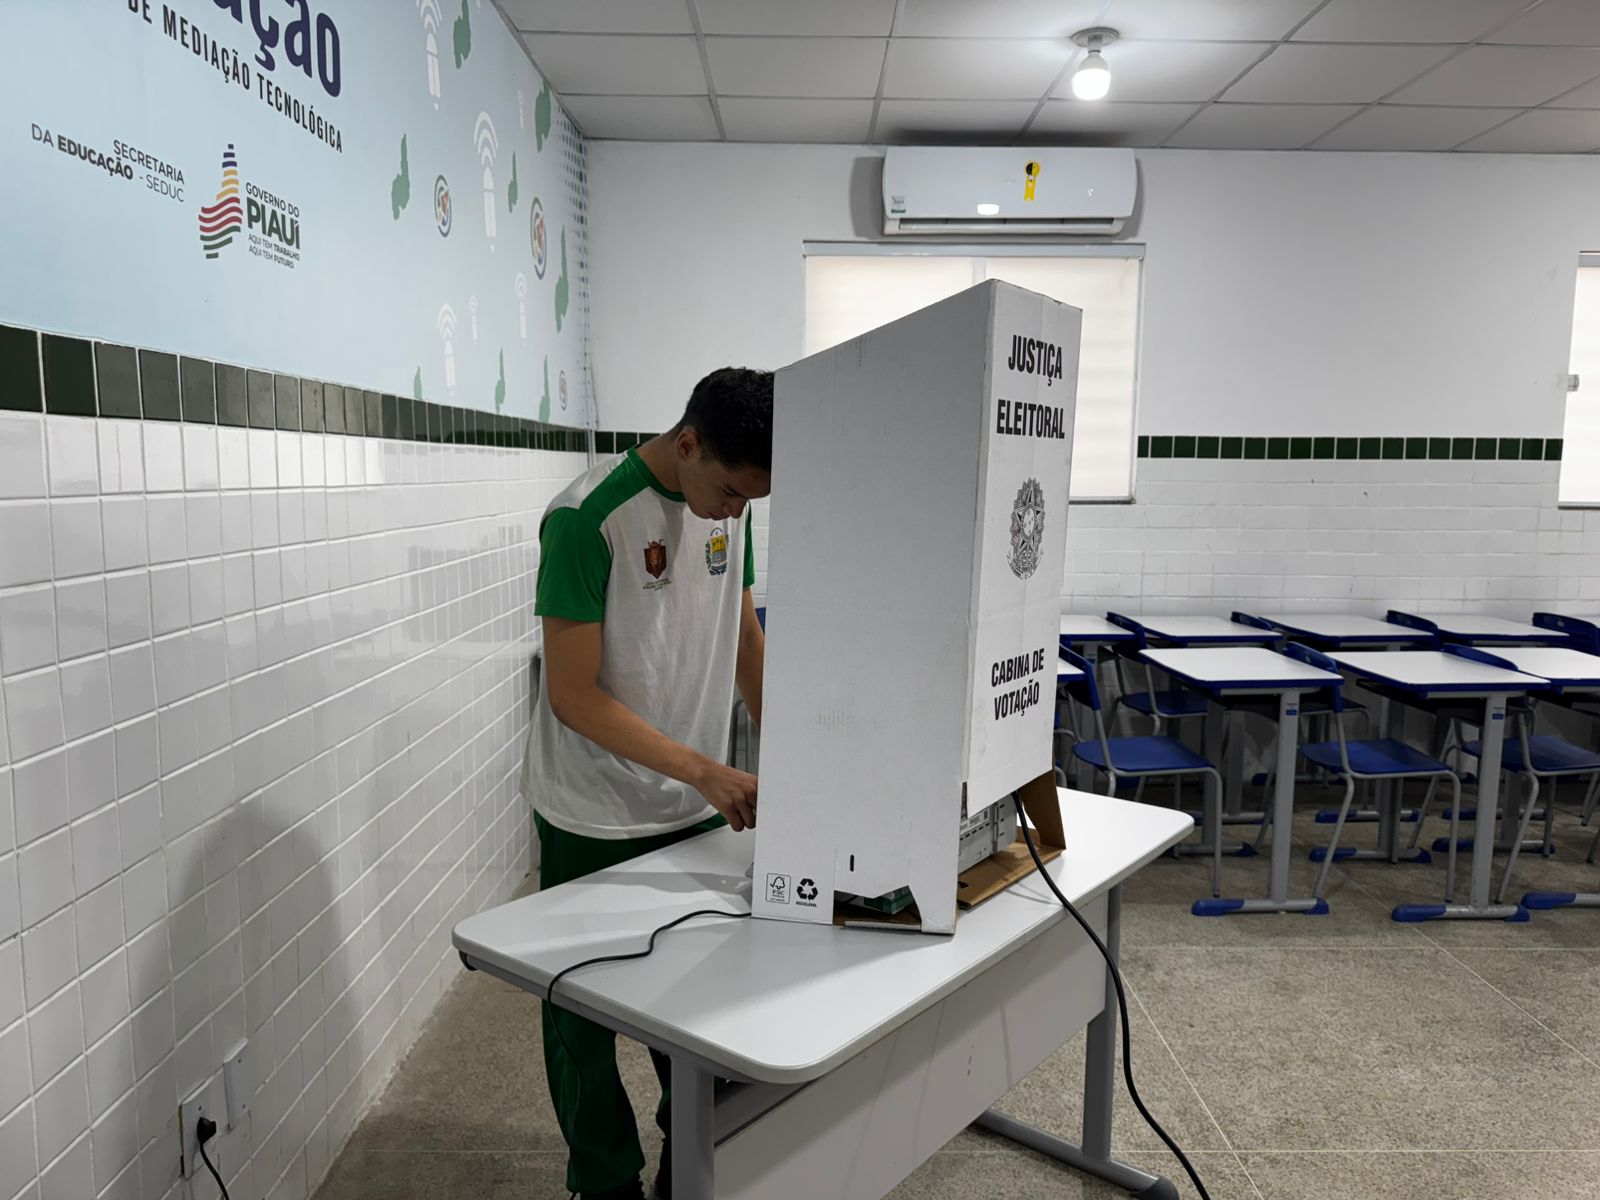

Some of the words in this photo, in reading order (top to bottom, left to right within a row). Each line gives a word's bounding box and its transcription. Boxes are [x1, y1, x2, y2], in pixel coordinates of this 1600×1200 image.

[163, 4, 250, 90] MEDIAÇÃO
[257, 72, 342, 153] TECNOLÓGICA
[31, 123, 54, 148] DA
[57, 134, 134, 180] EDUCAÇÃO
[146, 174, 185, 202] SEDUC
[113, 139, 185, 184] SECRETARIA
[245, 182, 286, 211] GOVERNO
[288, 203, 300, 218] DO
[246, 196, 301, 250] PIAUÍ
[248, 233, 261, 245] AQUI
[262, 238, 273, 250] TEM
[249, 245, 262, 257] AQUI
[262, 249, 273, 260] TEM
[1008, 334, 1063, 387] JUSTIÇA
[996, 399, 1065, 440] ELEITORAL
[991, 653, 1030, 688] CABINA
[1032, 647, 1045, 674] DE
[994, 678, 1040, 721] VOTAÇÃO
